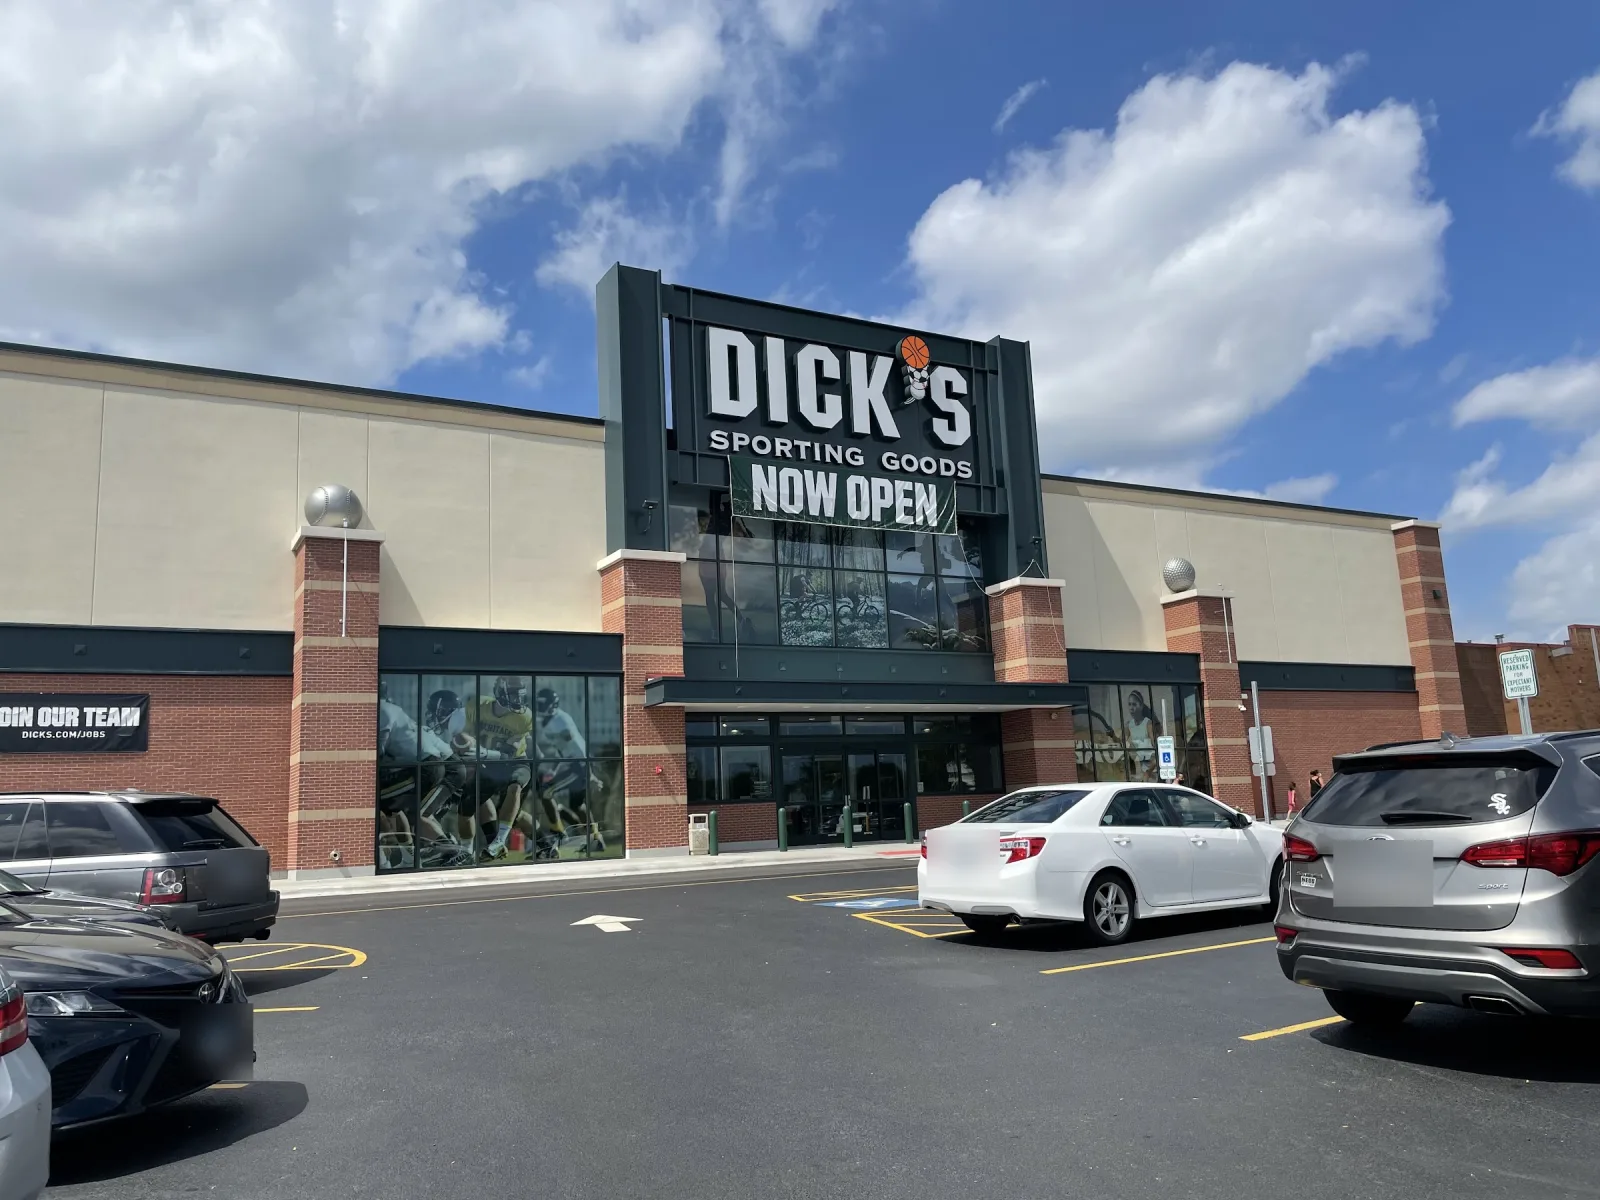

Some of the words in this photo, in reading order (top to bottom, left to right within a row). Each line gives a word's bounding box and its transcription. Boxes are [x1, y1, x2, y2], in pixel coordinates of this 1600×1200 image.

[706, 326, 971, 446] DICK'S
[709, 430, 865, 466] SPORTING
[881, 452, 973, 479] GOODS
[751, 463, 838, 518] NOW
[846, 475, 938, 527] OPEN
[1503, 655, 1530, 664] RESERVED
[1506, 663, 1529, 672] PARKING
[1507, 678, 1532, 687] EXPECTANT
[1510, 685, 1532, 693] MOTHERS
[37, 706, 80, 727] OUR
[83, 707, 141, 727] TEAM
[21, 730, 106, 739] DICKS.COM/JOBS
[1477, 882, 1509, 891] Sport
